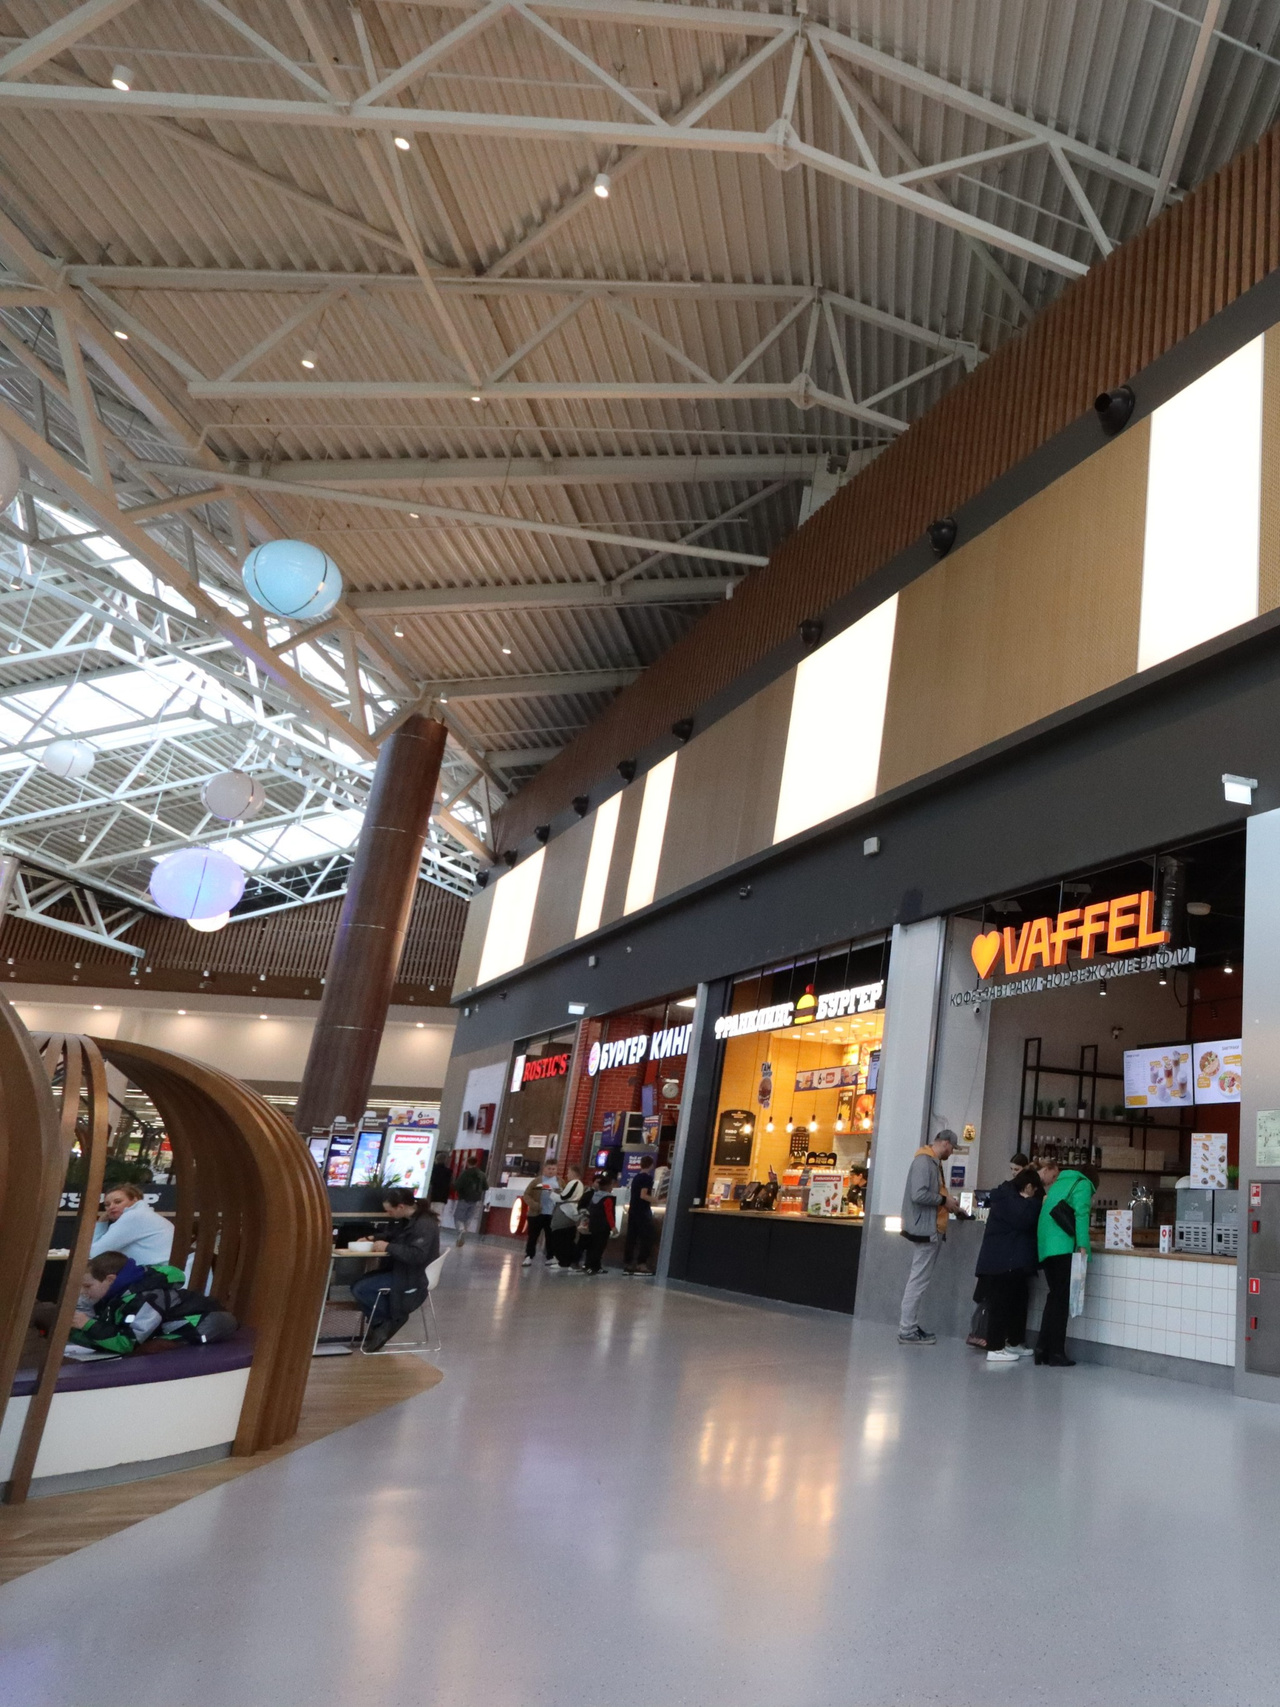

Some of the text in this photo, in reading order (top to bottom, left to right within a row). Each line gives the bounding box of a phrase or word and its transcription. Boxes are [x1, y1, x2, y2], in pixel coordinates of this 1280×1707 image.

[1003, 890, 1170, 975] VAFFEL
[715, 981, 883, 1039] ФРАНКЛИНС БУРГЕР
[523, 1053, 568, 1082] ROSTIC'S
[599, 1023, 693, 1071] БУРГЕР КИНГ
